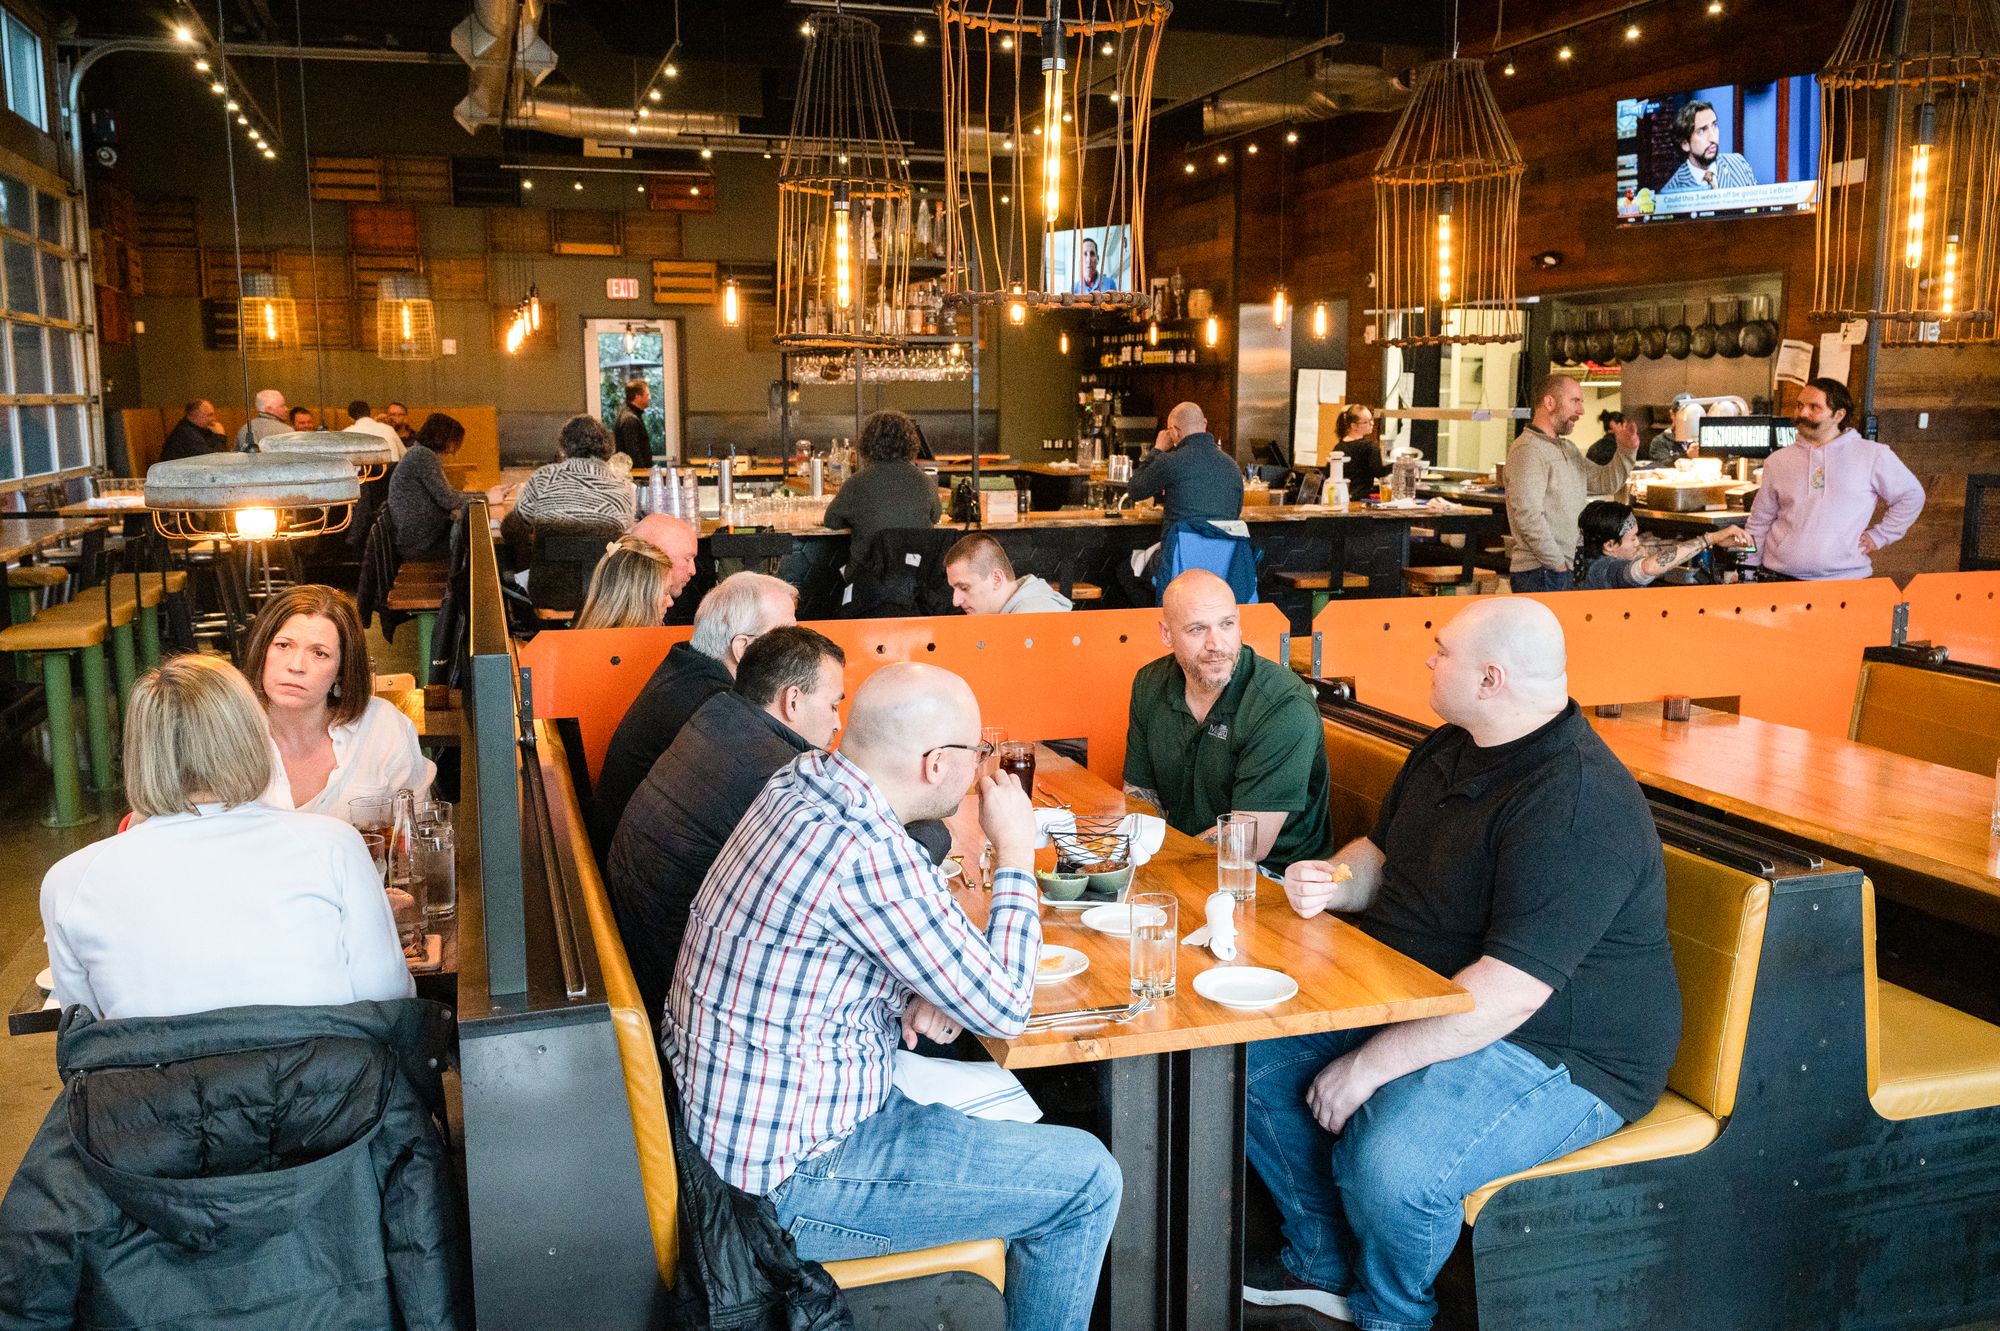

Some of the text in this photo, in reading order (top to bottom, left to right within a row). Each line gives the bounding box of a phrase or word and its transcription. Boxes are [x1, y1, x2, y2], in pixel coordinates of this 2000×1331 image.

[1663, 194, 1682, 203] Could
[1682, 193, 1694, 202] this
[1700, 192, 1721, 200] weeks
[1732, 190, 1741, 198] be
[1769, 185, 1799, 195] LeBron?
[612, 279, 634, 298] EXIT
